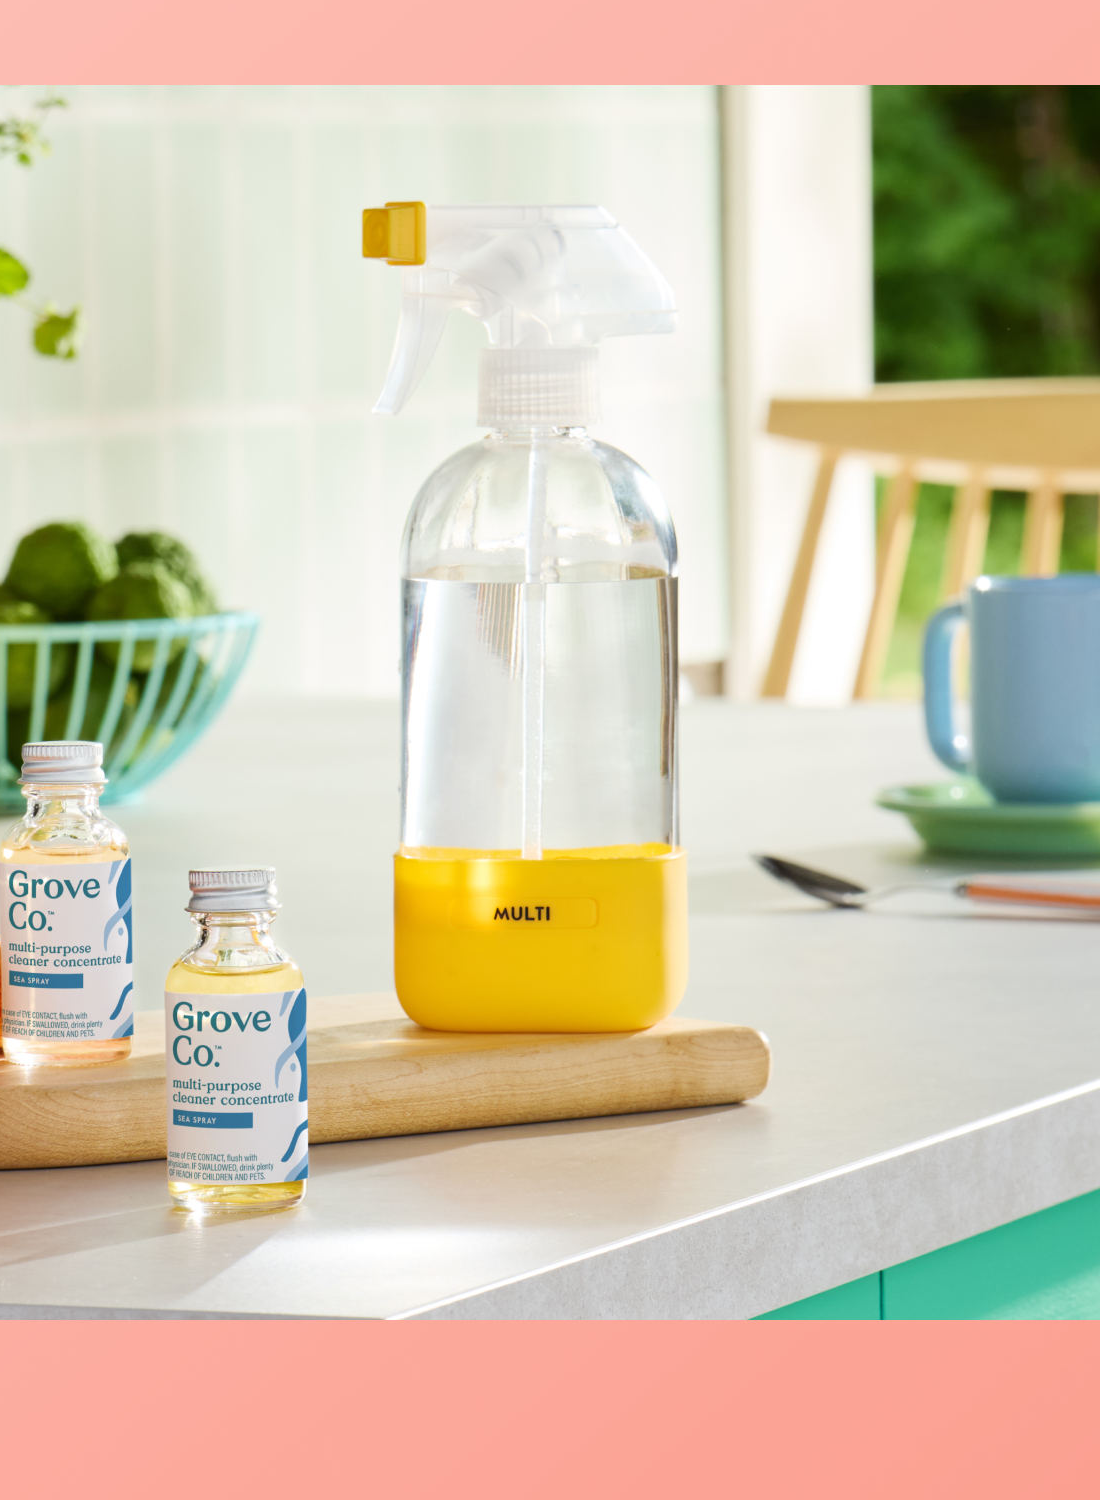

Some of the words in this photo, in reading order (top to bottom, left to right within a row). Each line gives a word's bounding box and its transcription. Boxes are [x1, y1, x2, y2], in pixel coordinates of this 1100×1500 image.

[8, 869, 101, 899] Grove
[493, 906, 551, 921] MULTI
[8, 942, 92, 956] multi-purpose
[8, 954, 49, 967] cleaner
[53, 955, 122, 967] concentrate
[13, 975, 25, 983] SEA
[27, 977, 50, 985] SPRAY
[16, 1009, 22, 1017] of
[22, 1010, 31, 1019] EYE
[32, 1011, 58, 1020] CONTACT,
[59, 1012, 74, 1020] flush
[75, 1012, 88, 1020] with
[172, 1001, 272, 1033] Grove
[3, 1017, 26, 1027] physician.
[26, 1019, 32, 1027] IF
[32, 1020, 70, 1029] SWALLOWED,
[71, 1020, 86, 1029] drink
[86, 1020, 103, 1029] plenty
[11, 1026, 28, 1036] REACH
[28, 1028, 36, 1036] OF
[36, 1029, 65, 1038] CHILDREN
[66, 1030, 79, 1038] AND
[80, 1029, 95, 1038] PETS.
[172, 1078, 262, 1094] multi-purpose
[172, 1091, 216, 1106] cleaner
[220, 1092, 294, 1106] concentrate
[177, 1114, 190, 1123] SEA
[192, 1116, 217, 1125] SPRAY
[180, 1151, 187, 1160] of
[186, 1152, 197, 1160] EYE
[197, 1153, 225, 1163] CONTACT,
[226, 1153, 242, 1162] flush
[243, 1153, 258, 1162] with
[191, 1162, 198, 1170] IF
[197, 1162, 239, 1173] SWALLOWED,
[239, 1163, 256, 1172] drink
[256, 1162, 275, 1173] plenty
[168, 1168, 175, 1177] OF
[175, 1169, 193, 1179] REACH
[193, 1171, 201, 1180] OF
[201, 1172, 233, 1181] CHILDREN
[234, 1173, 249, 1181] AND
[249, 1172, 266, 1181] PETS.
